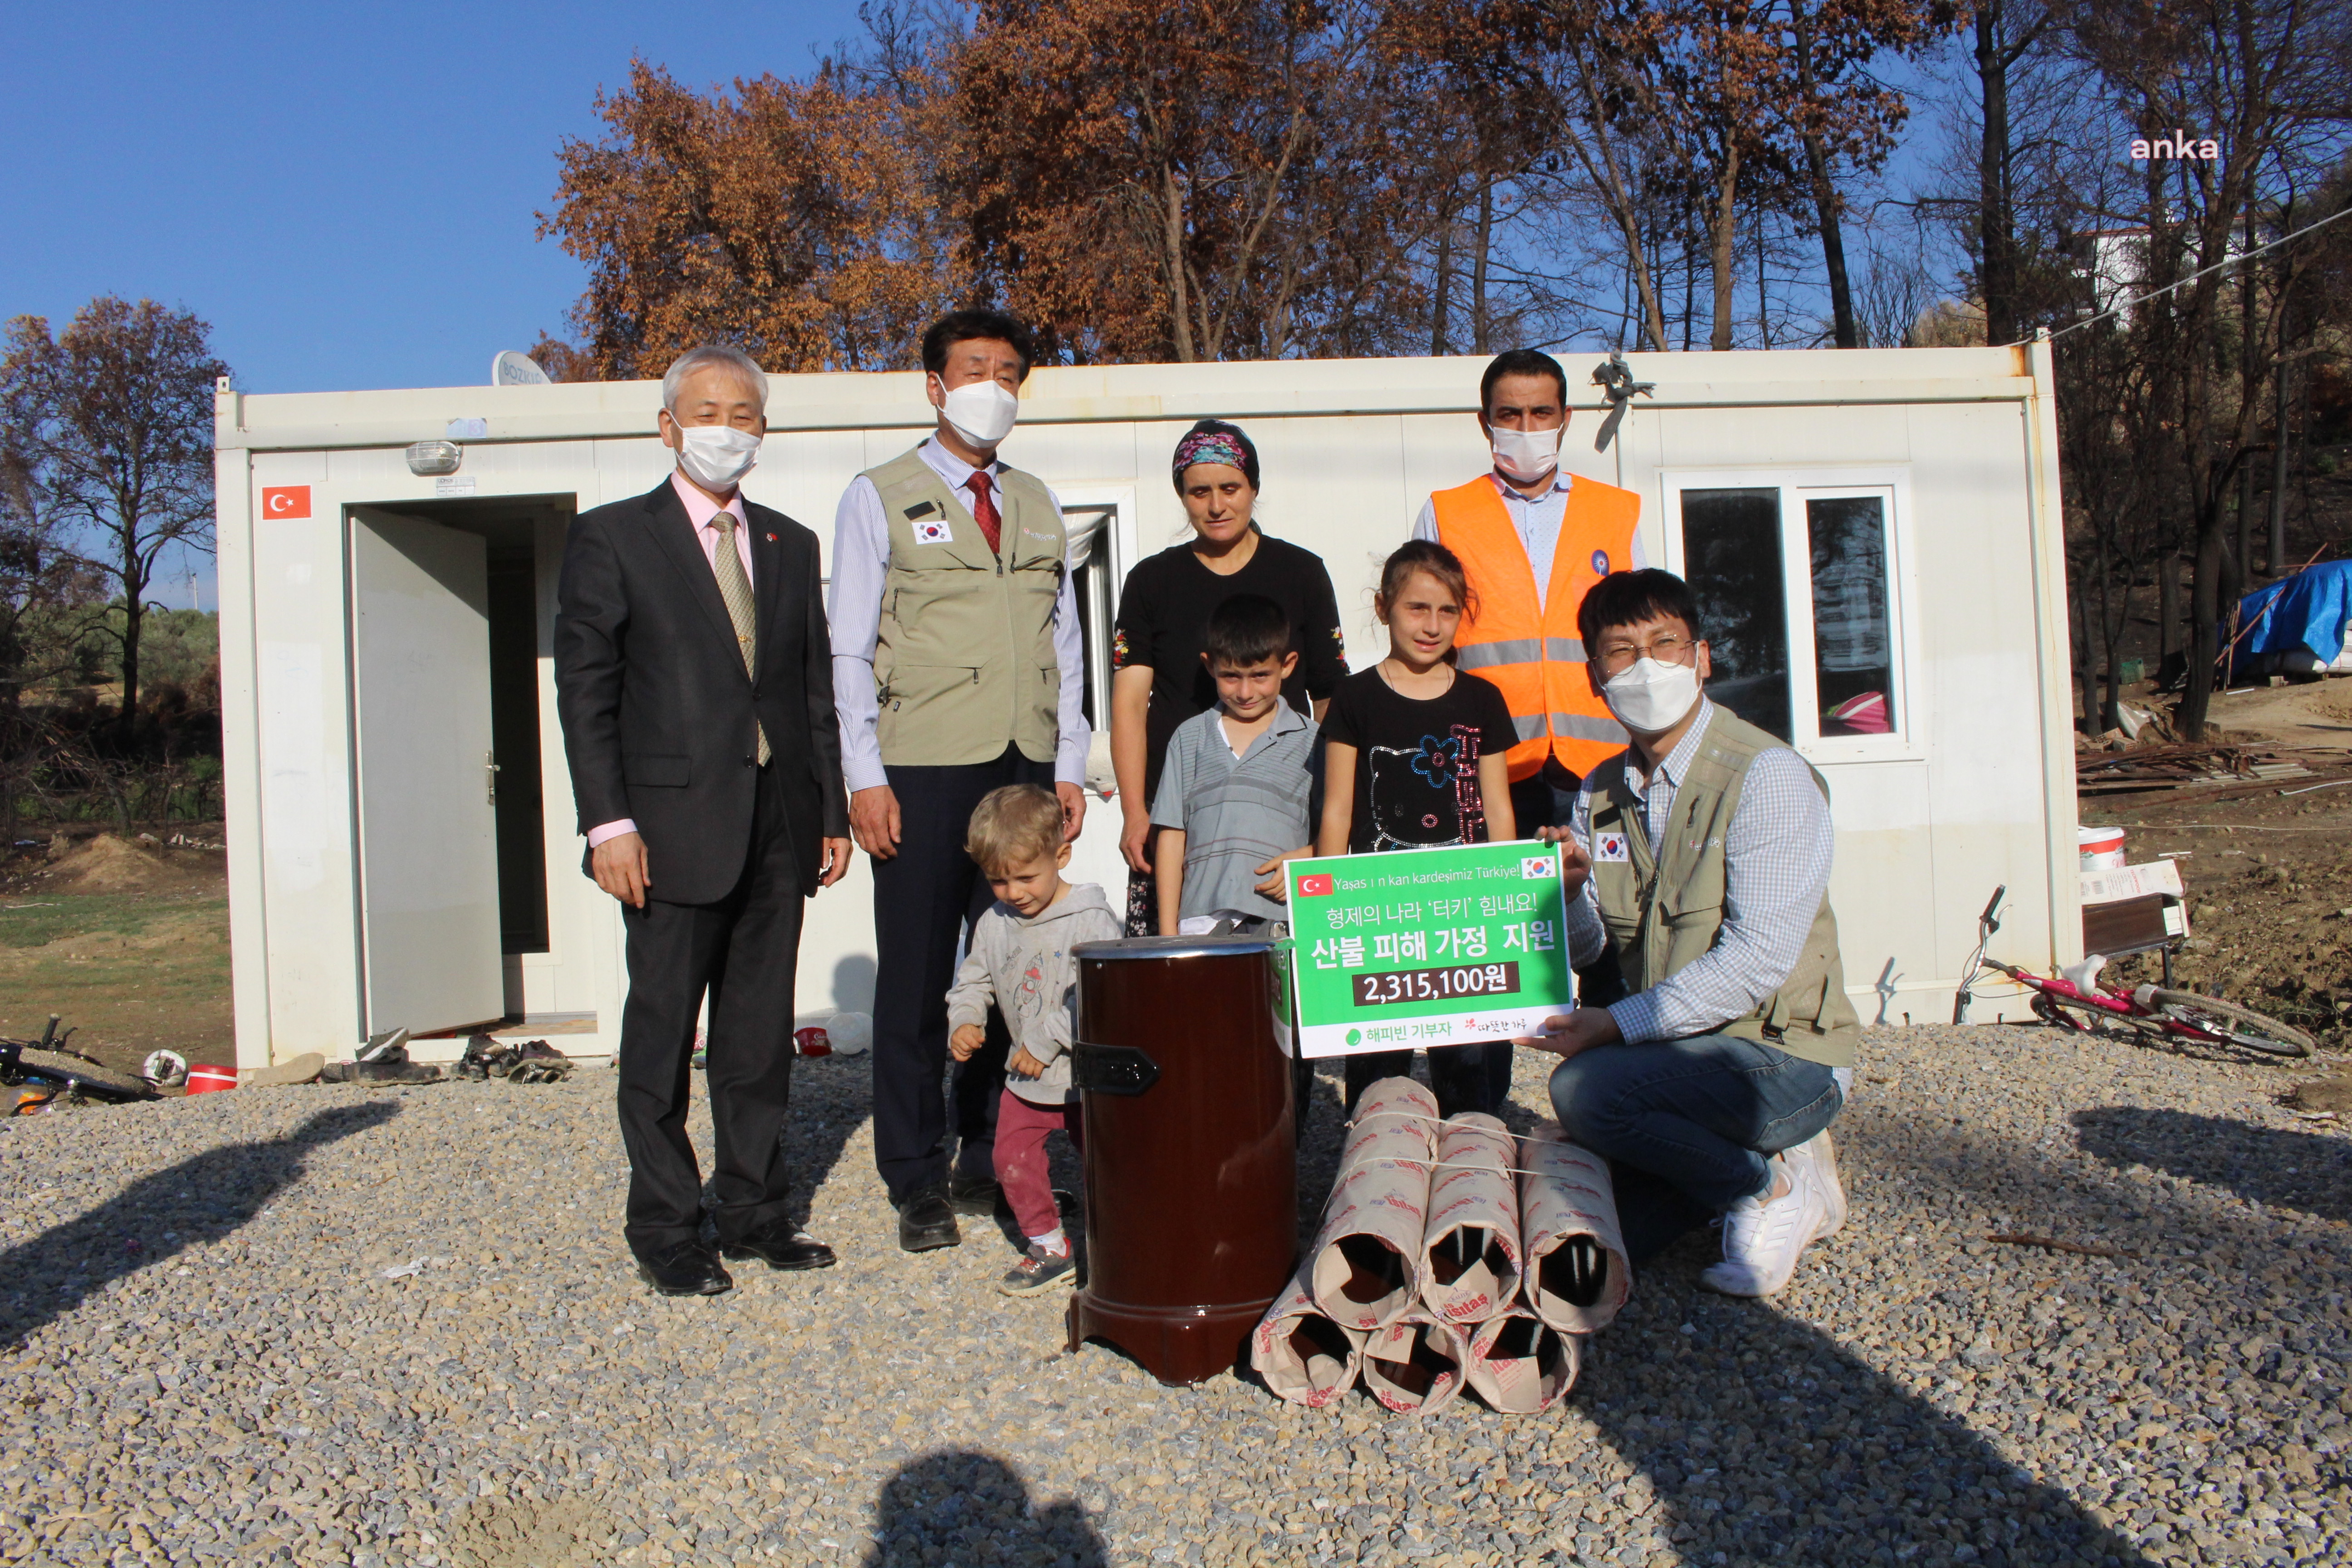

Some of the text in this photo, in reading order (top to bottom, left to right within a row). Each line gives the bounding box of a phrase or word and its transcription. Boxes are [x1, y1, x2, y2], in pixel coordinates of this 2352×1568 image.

[1334, 878, 1367, 891] Yaşas
[1388, 874, 1409, 886] kan
[1413, 868, 1473, 883] kardeşimiz
[1475, 864, 1520, 879] Türkiye!
[1326, 905, 1380, 929] 형제의
[1386, 901, 1422, 924] 나라
[1479, 892, 1538, 917] 힘내요!
[1311, 920, 1555, 969] 산불 피해 가정 지원
[1363, 964, 1507, 1004] 2,315,100원
[1366, 1021, 1452, 1042] 해피빈 기부자
[1477, 1020, 1509, 1033] 따뜻한
